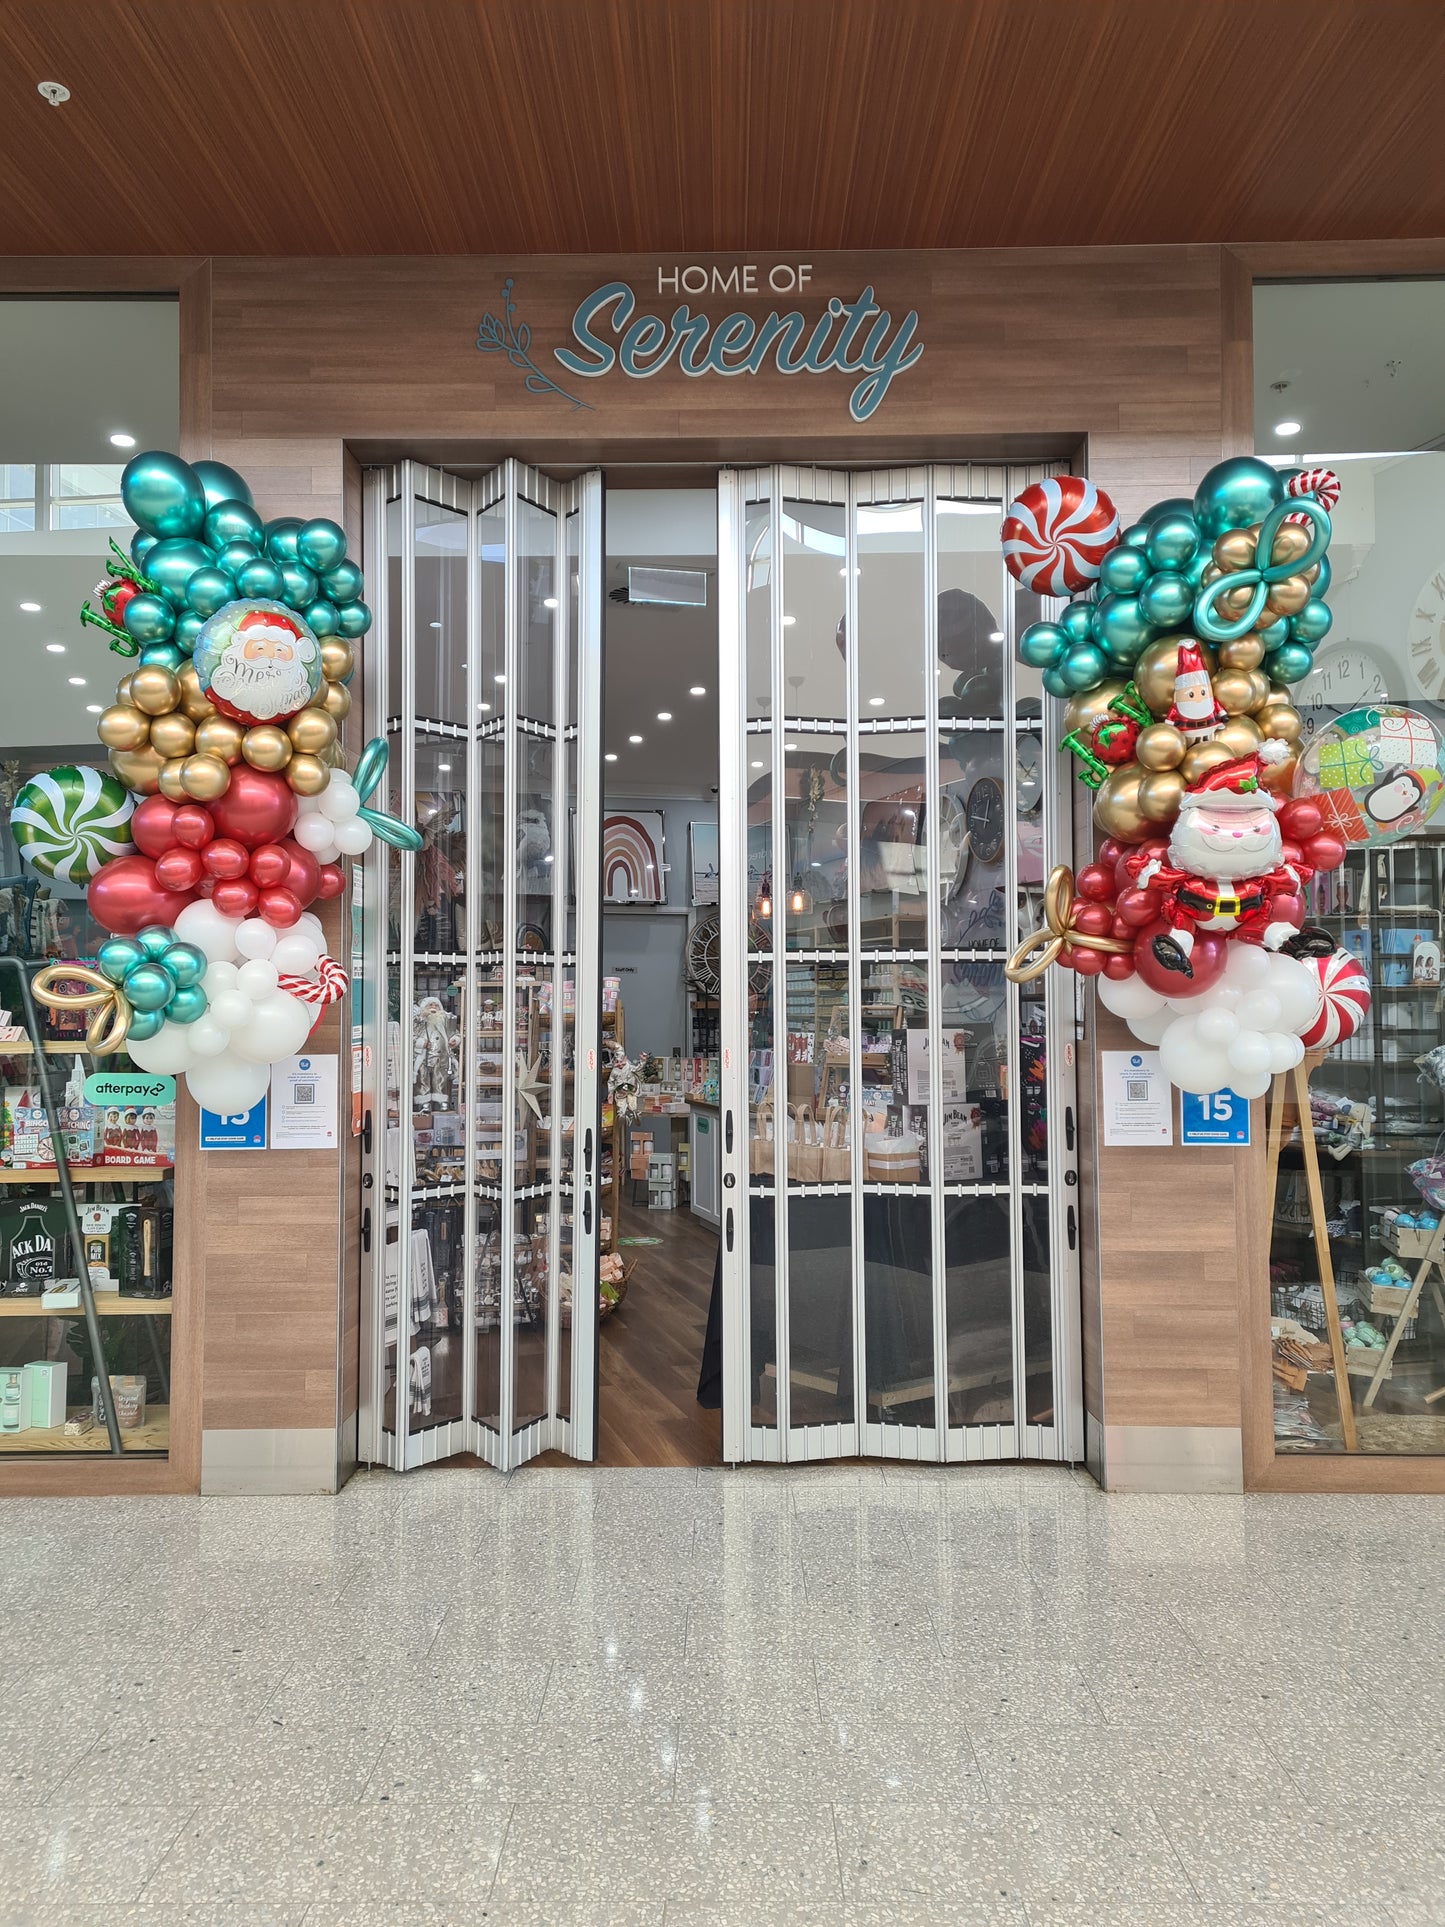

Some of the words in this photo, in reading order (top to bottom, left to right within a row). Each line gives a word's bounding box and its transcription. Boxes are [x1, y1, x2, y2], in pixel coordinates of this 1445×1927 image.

[658, 266, 757, 294] HOME
[768, 265, 812, 293] OF
[553, 282, 925, 423] Serenity
[95, 1083, 150, 1096] afterpay
[1197, 1095, 1233, 1122] 15
[105, 1156, 133, 1165] BOARD
[133, 1155, 156, 1165] GAME
[19, 1204, 31, 1213] JACK
[85, 1205, 97, 1215] JIM
[96, 1204, 110, 1215] BEAM
[90, 1245, 102, 1253] PUB
[90, 1252, 102, 1260] MIX
